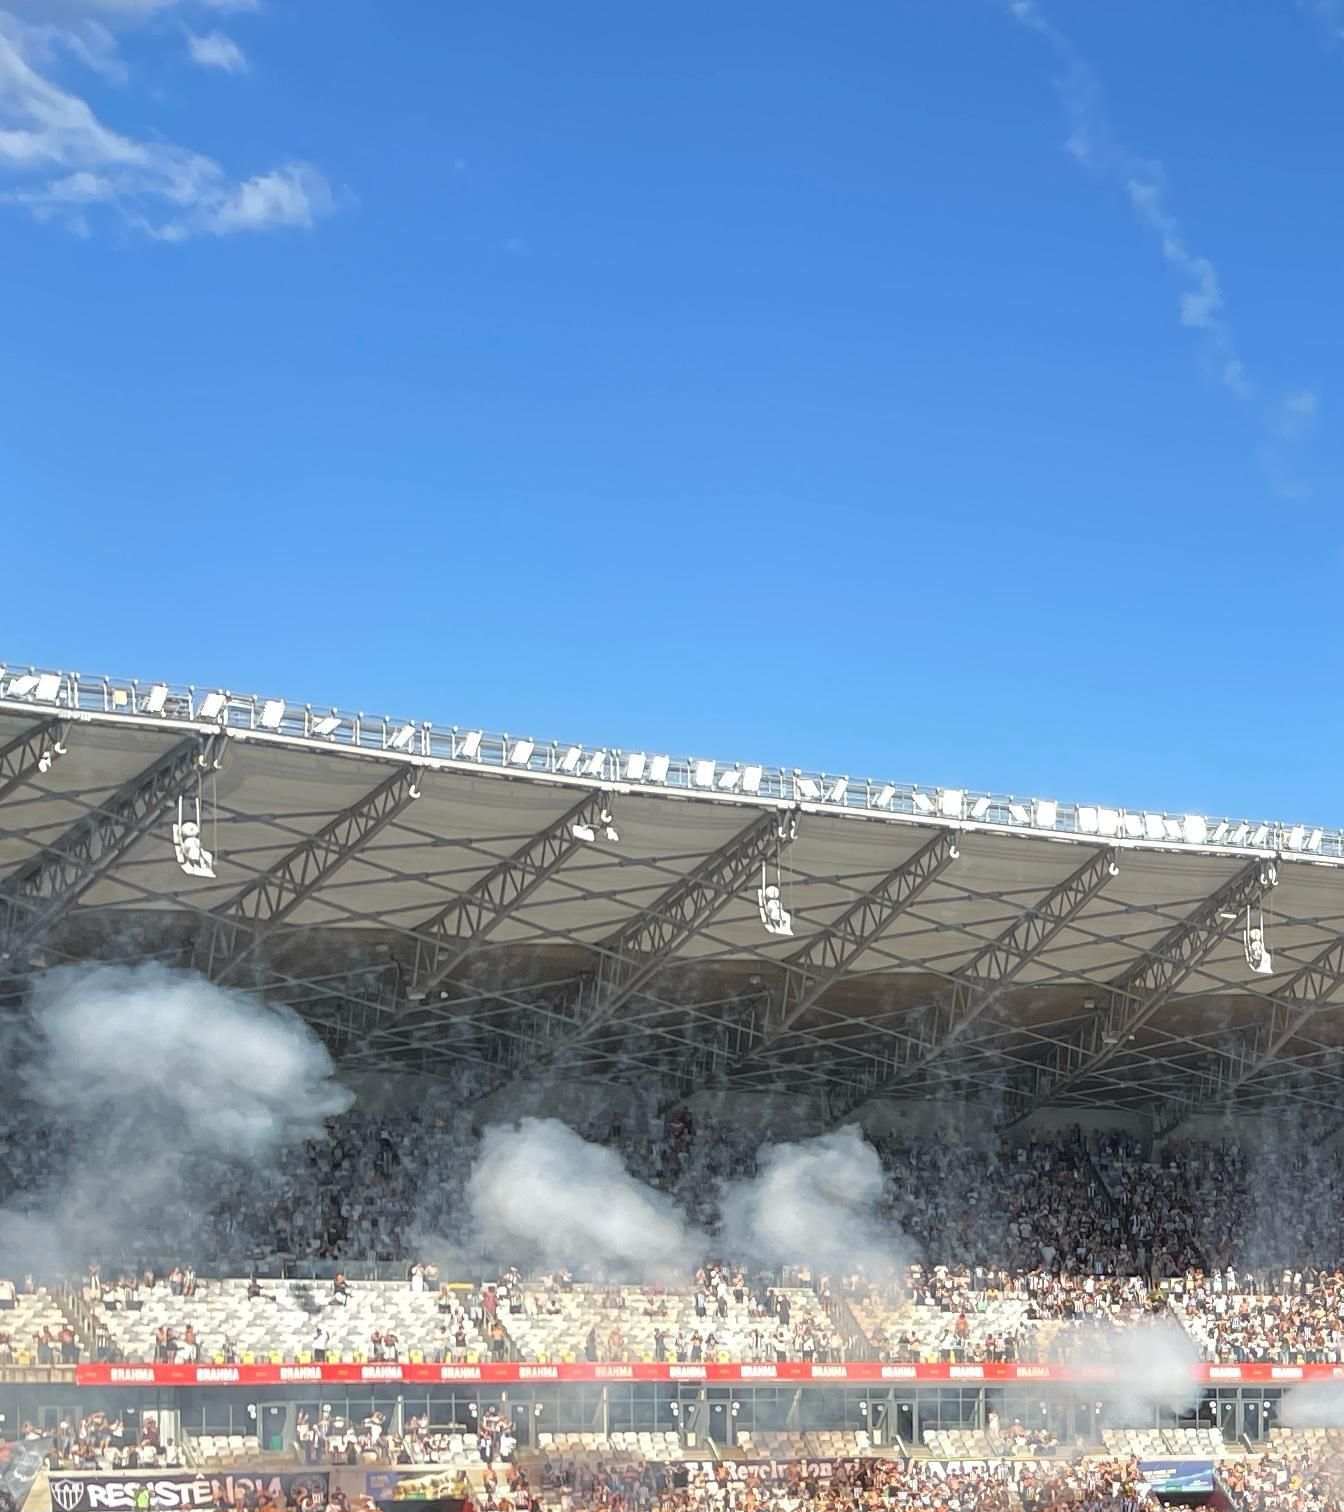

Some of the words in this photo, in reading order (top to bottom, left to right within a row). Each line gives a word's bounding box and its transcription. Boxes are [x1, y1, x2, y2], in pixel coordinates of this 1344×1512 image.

[111, 1368, 154, 1381] BRAHMA
[197, 1368, 239, 1381] BRAHMA
[280, 1366, 322, 1380] BRAHMA
[361, 1366, 402, 1379] BRAHMA
[519, 1366, 558, 1379] BRAHMA
[88, 1473, 282, 1508] RESSTÊNIA
